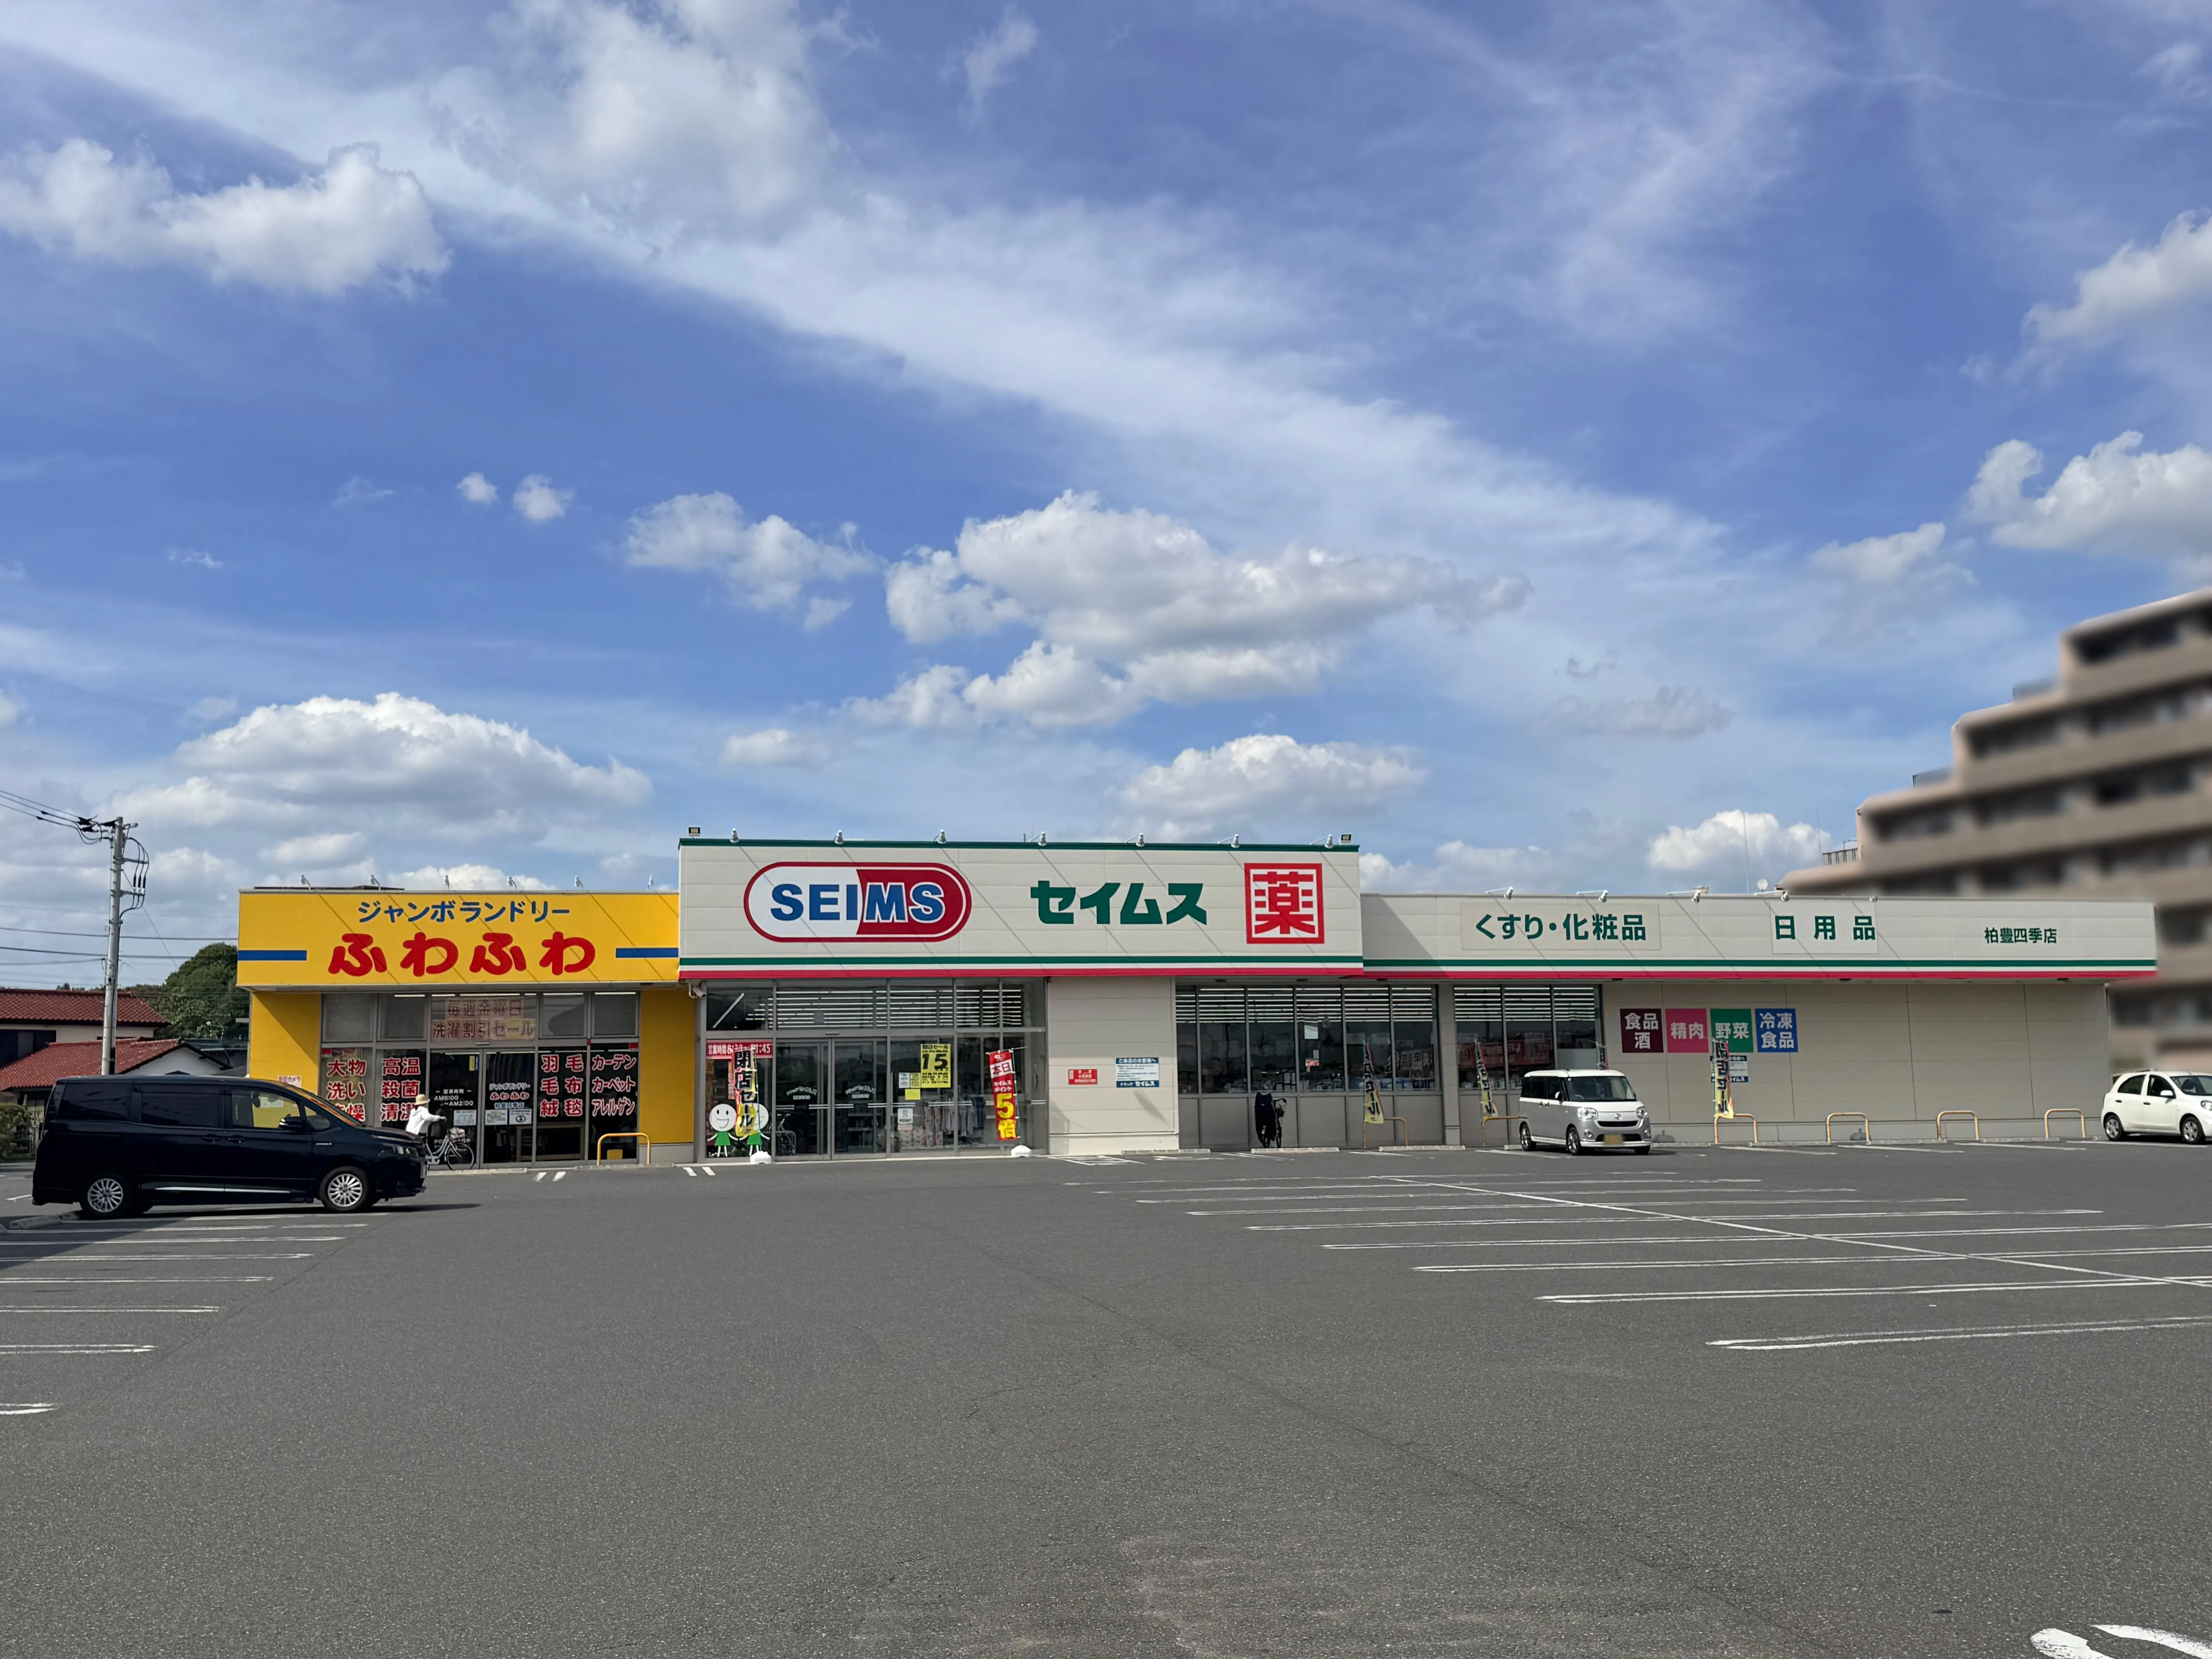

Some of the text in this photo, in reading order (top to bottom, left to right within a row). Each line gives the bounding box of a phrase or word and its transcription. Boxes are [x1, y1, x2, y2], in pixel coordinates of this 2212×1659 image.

[771, 882, 945, 924] SEIMS
[1030, 880, 1207, 926] セイムス
[1253, 871, 1315, 934] 薬
[358, 900, 570, 924] ジャンボランドリー
[1476, 914, 1647, 941] くすり・化粧品
[1775, 915, 1876, 940] 日用品
[1984, 927, 2057, 944] 柏豊四季店
[328, 931, 596, 977] ふわふわ
[448, 999, 521, 1016] 毎週金曜日
[433, 1020, 533, 1038] 洗濯割引セール
[1625, 1013, 1659, 1030] 食品
[1760, 1012, 1793, 1030] 冷凍
[1671, 1022, 1704, 1040] 精肉
[1715, 1023, 1749, 1040] 野菜
[1761, 1031, 1795, 1049] 食品
[1634, 1032, 1651, 1049] 酒
[327, 1058, 367, 1077] 大物
[382, 1057, 421, 1075] 高温
[541, 1054, 584, 1073] 羽毛
[592, 1054, 637, 1071] カーテン
[991, 1062, 1010, 1075] 本日
[326, 1081, 366, 1100] 洗い
[381, 1080, 421, 1098] 殺菌
[541, 1076, 584, 1095] 毛布
[592, 1075, 636, 1093] カーペット
[335, 1103, 365, 1121] 燥
[592, 1096, 635, 1116] アレルゲン
[997, 1093, 1014, 1119] 5
